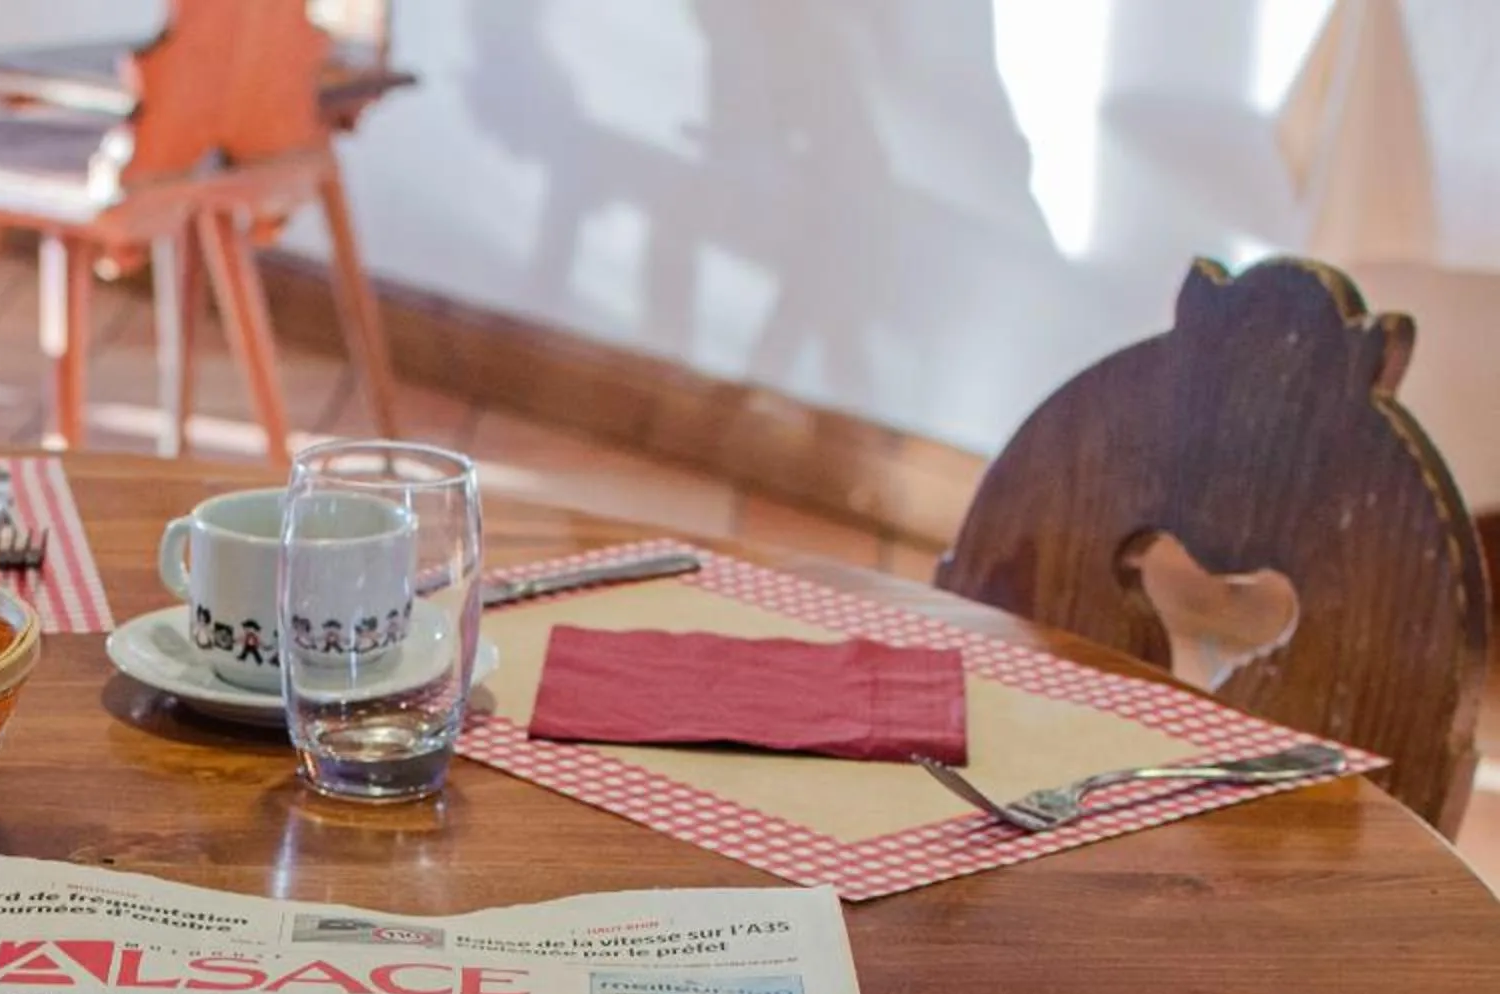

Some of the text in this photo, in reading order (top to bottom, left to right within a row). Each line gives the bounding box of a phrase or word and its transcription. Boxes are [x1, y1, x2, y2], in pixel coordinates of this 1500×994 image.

[29, 891, 60, 902] de
[69, 892, 249, 926] fréquentation
[105, 908, 232, 932] d'octobre
[537, 938, 565, 949] de
[572, 937, 593, 949] la
[600, 931, 682, 947] vitesse
[688, 927, 724, 940] sur
[731, 920, 791, 936] l'A35
[583, 948, 619, 959] par
[629, 946, 650, 957] le
[656, 940, 729, 959] préfet
